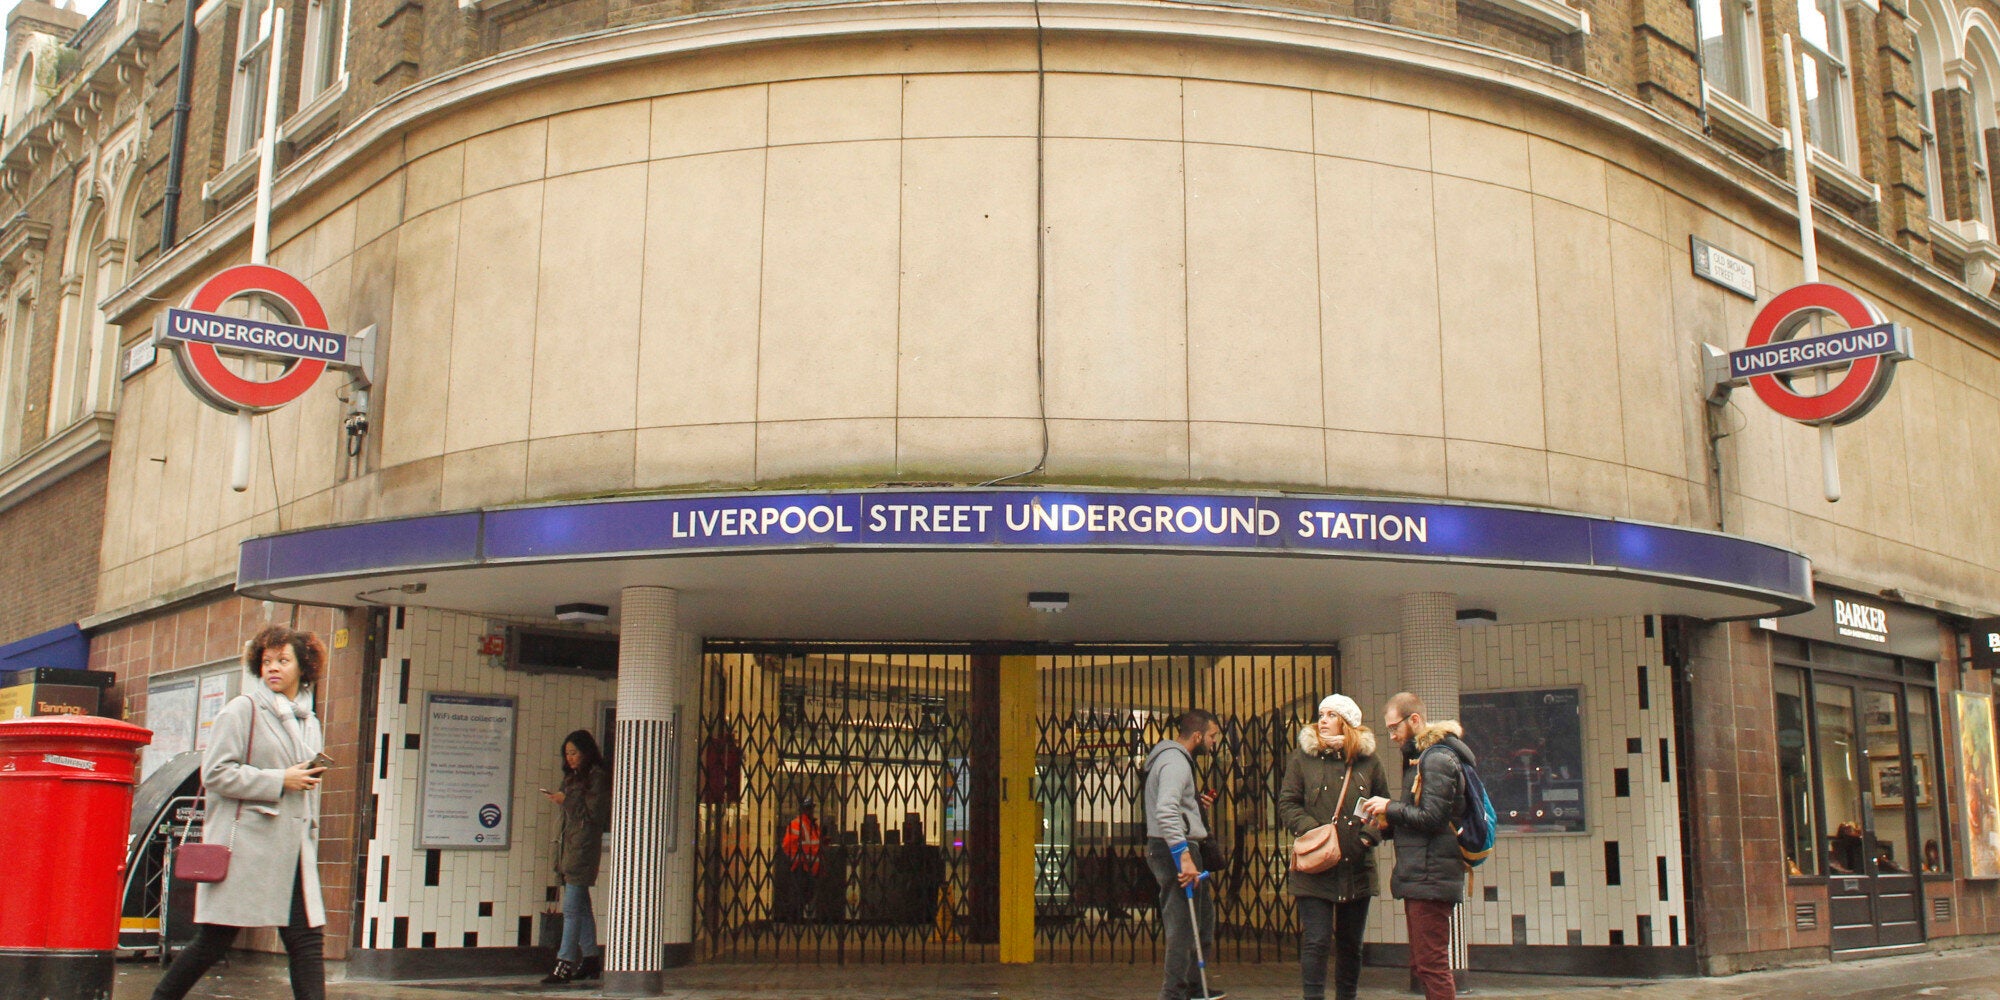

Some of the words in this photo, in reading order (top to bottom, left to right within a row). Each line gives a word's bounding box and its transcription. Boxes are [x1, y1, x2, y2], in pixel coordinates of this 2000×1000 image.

[1713, 253, 1726, 267] OLD
[1727, 258, 1746, 276] BROAD
[1714, 265, 1735, 282] STREET
[174, 315, 340, 355] UNDERGROUND
[1735, 331, 1889, 372] UNDERGROUND
[672, 505, 853, 538] LIVERPOOL
[868, 504, 993, 532] STREET
[1005, 504, 1281, 536] UNDERGROUND
[1298, 510, 1428, 542] STATION
[1835, 599, 1888, 634] BARKER
[38, 701, 81, 715] Tanning
[433, 711, 450, 720] WiFi
[451, 713, 469, 721] data
[470, 714, 507, 723] collection
